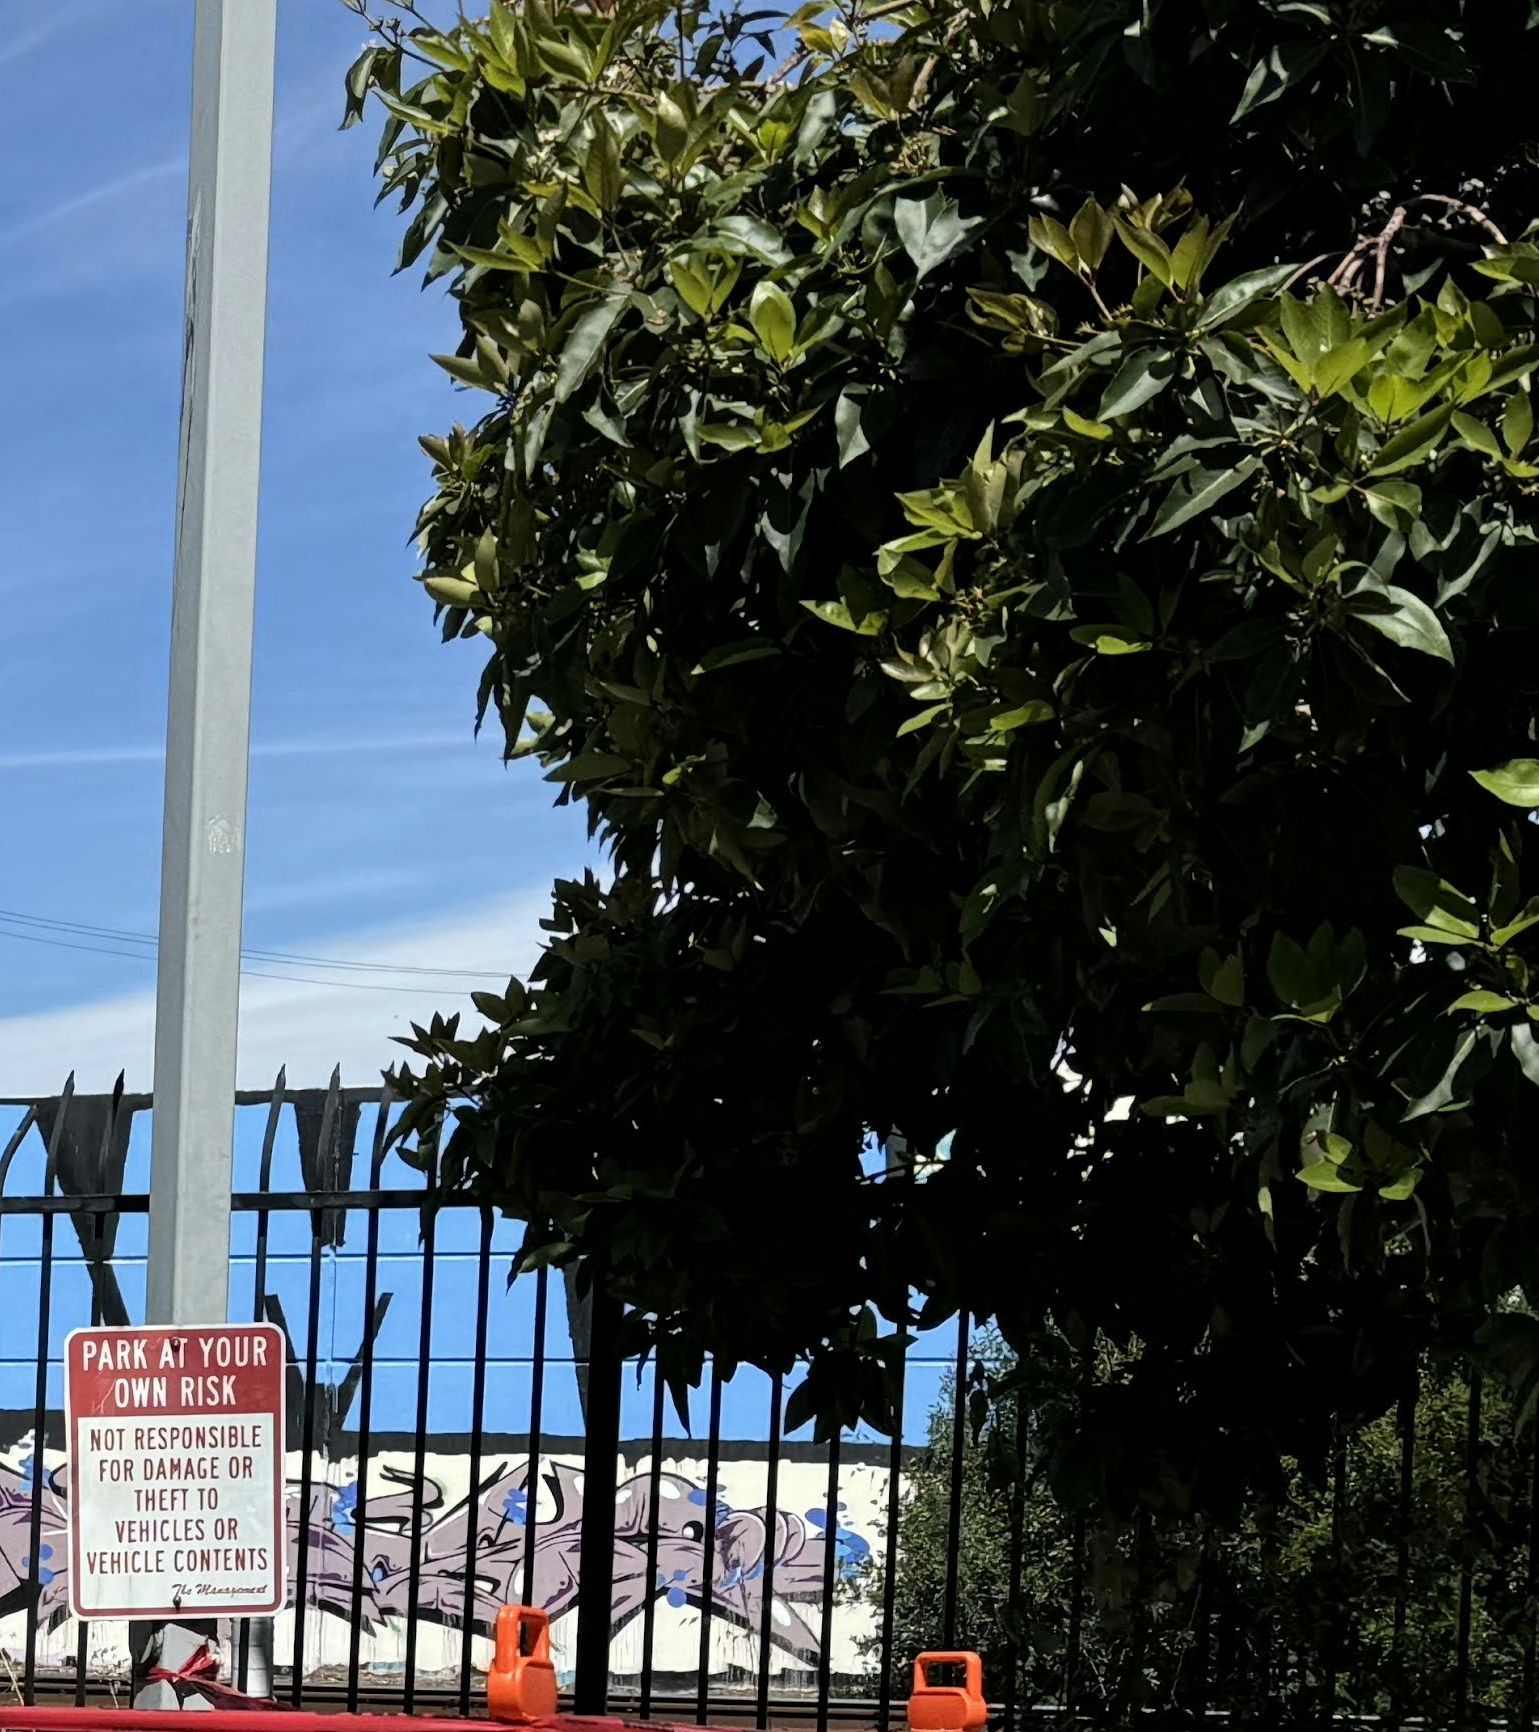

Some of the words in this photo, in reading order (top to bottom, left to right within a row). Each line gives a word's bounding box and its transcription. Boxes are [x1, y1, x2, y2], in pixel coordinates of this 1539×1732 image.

[82, 1338, 148, 1371] PARK
[159, 1338, 189, 1369] AT
[200, 1336, 268, 1368] YOUR
[114, 1377, 167, 1408] OWN
[180, 1375, 237, 1407] RISK
[90, 1428, 125, 1451] NOT
[135, 1425, 262, 1450] RESPONSIBLE
[99, 1459, 134, 1482] FOR
[143, 1457, 220, 1481] DAMAGE
[229, 1456, 253, 1479] OR
[134, 1488, 189, 1512] THEFT
[197, 1487, 219, 1511] TO
[115, 1519, 205, 1544] VEHICLES
[214, 1518, 238, 1540] OR
[87, 1550, 165, 1575] VEHICLE
[174, 1548, 268, 1573] CONTENTS
